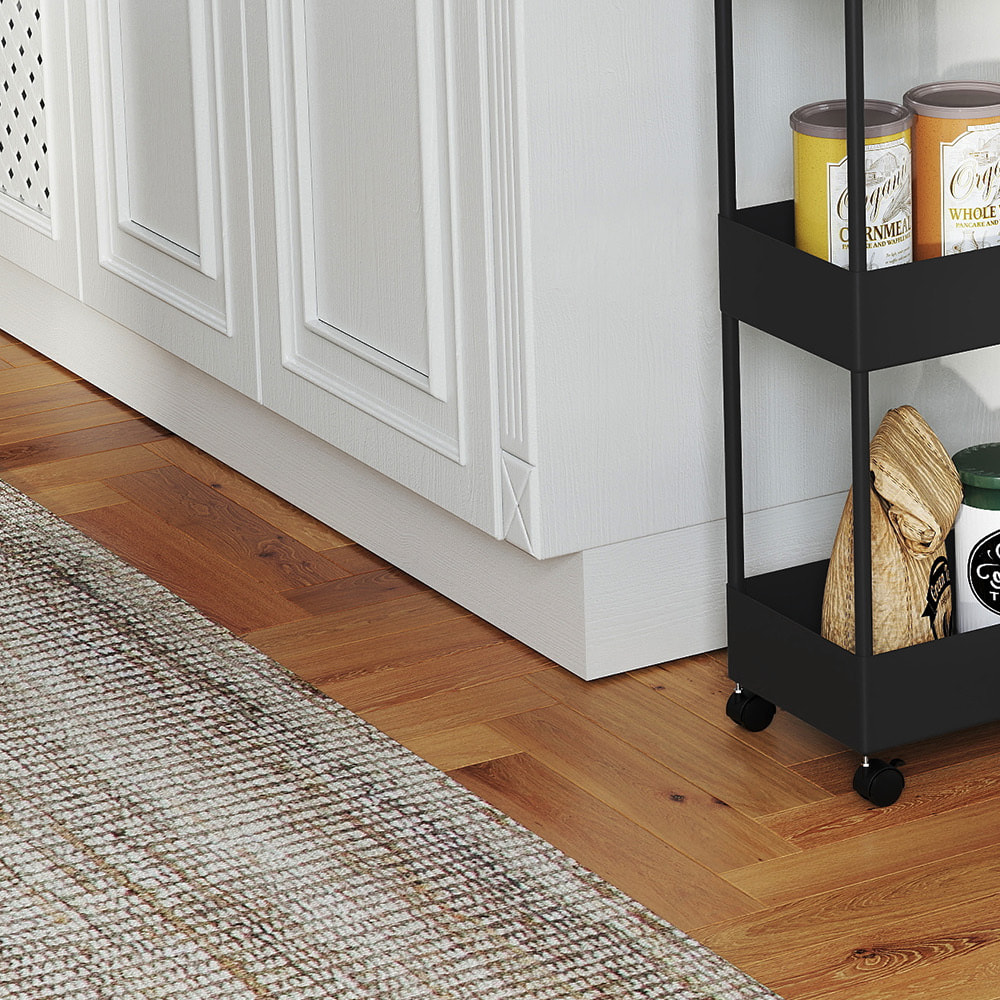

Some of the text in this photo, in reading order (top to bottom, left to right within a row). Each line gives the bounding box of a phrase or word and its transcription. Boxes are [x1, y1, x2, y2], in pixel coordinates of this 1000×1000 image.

[948, 205, 996, 221] WHOLE
[839, 215, 912, 243] CRNMEAL
[955, 221, 986, 229] PANCAKE
[986, 219, 999, 227] AND
[873, 240, 887, 249] AND
